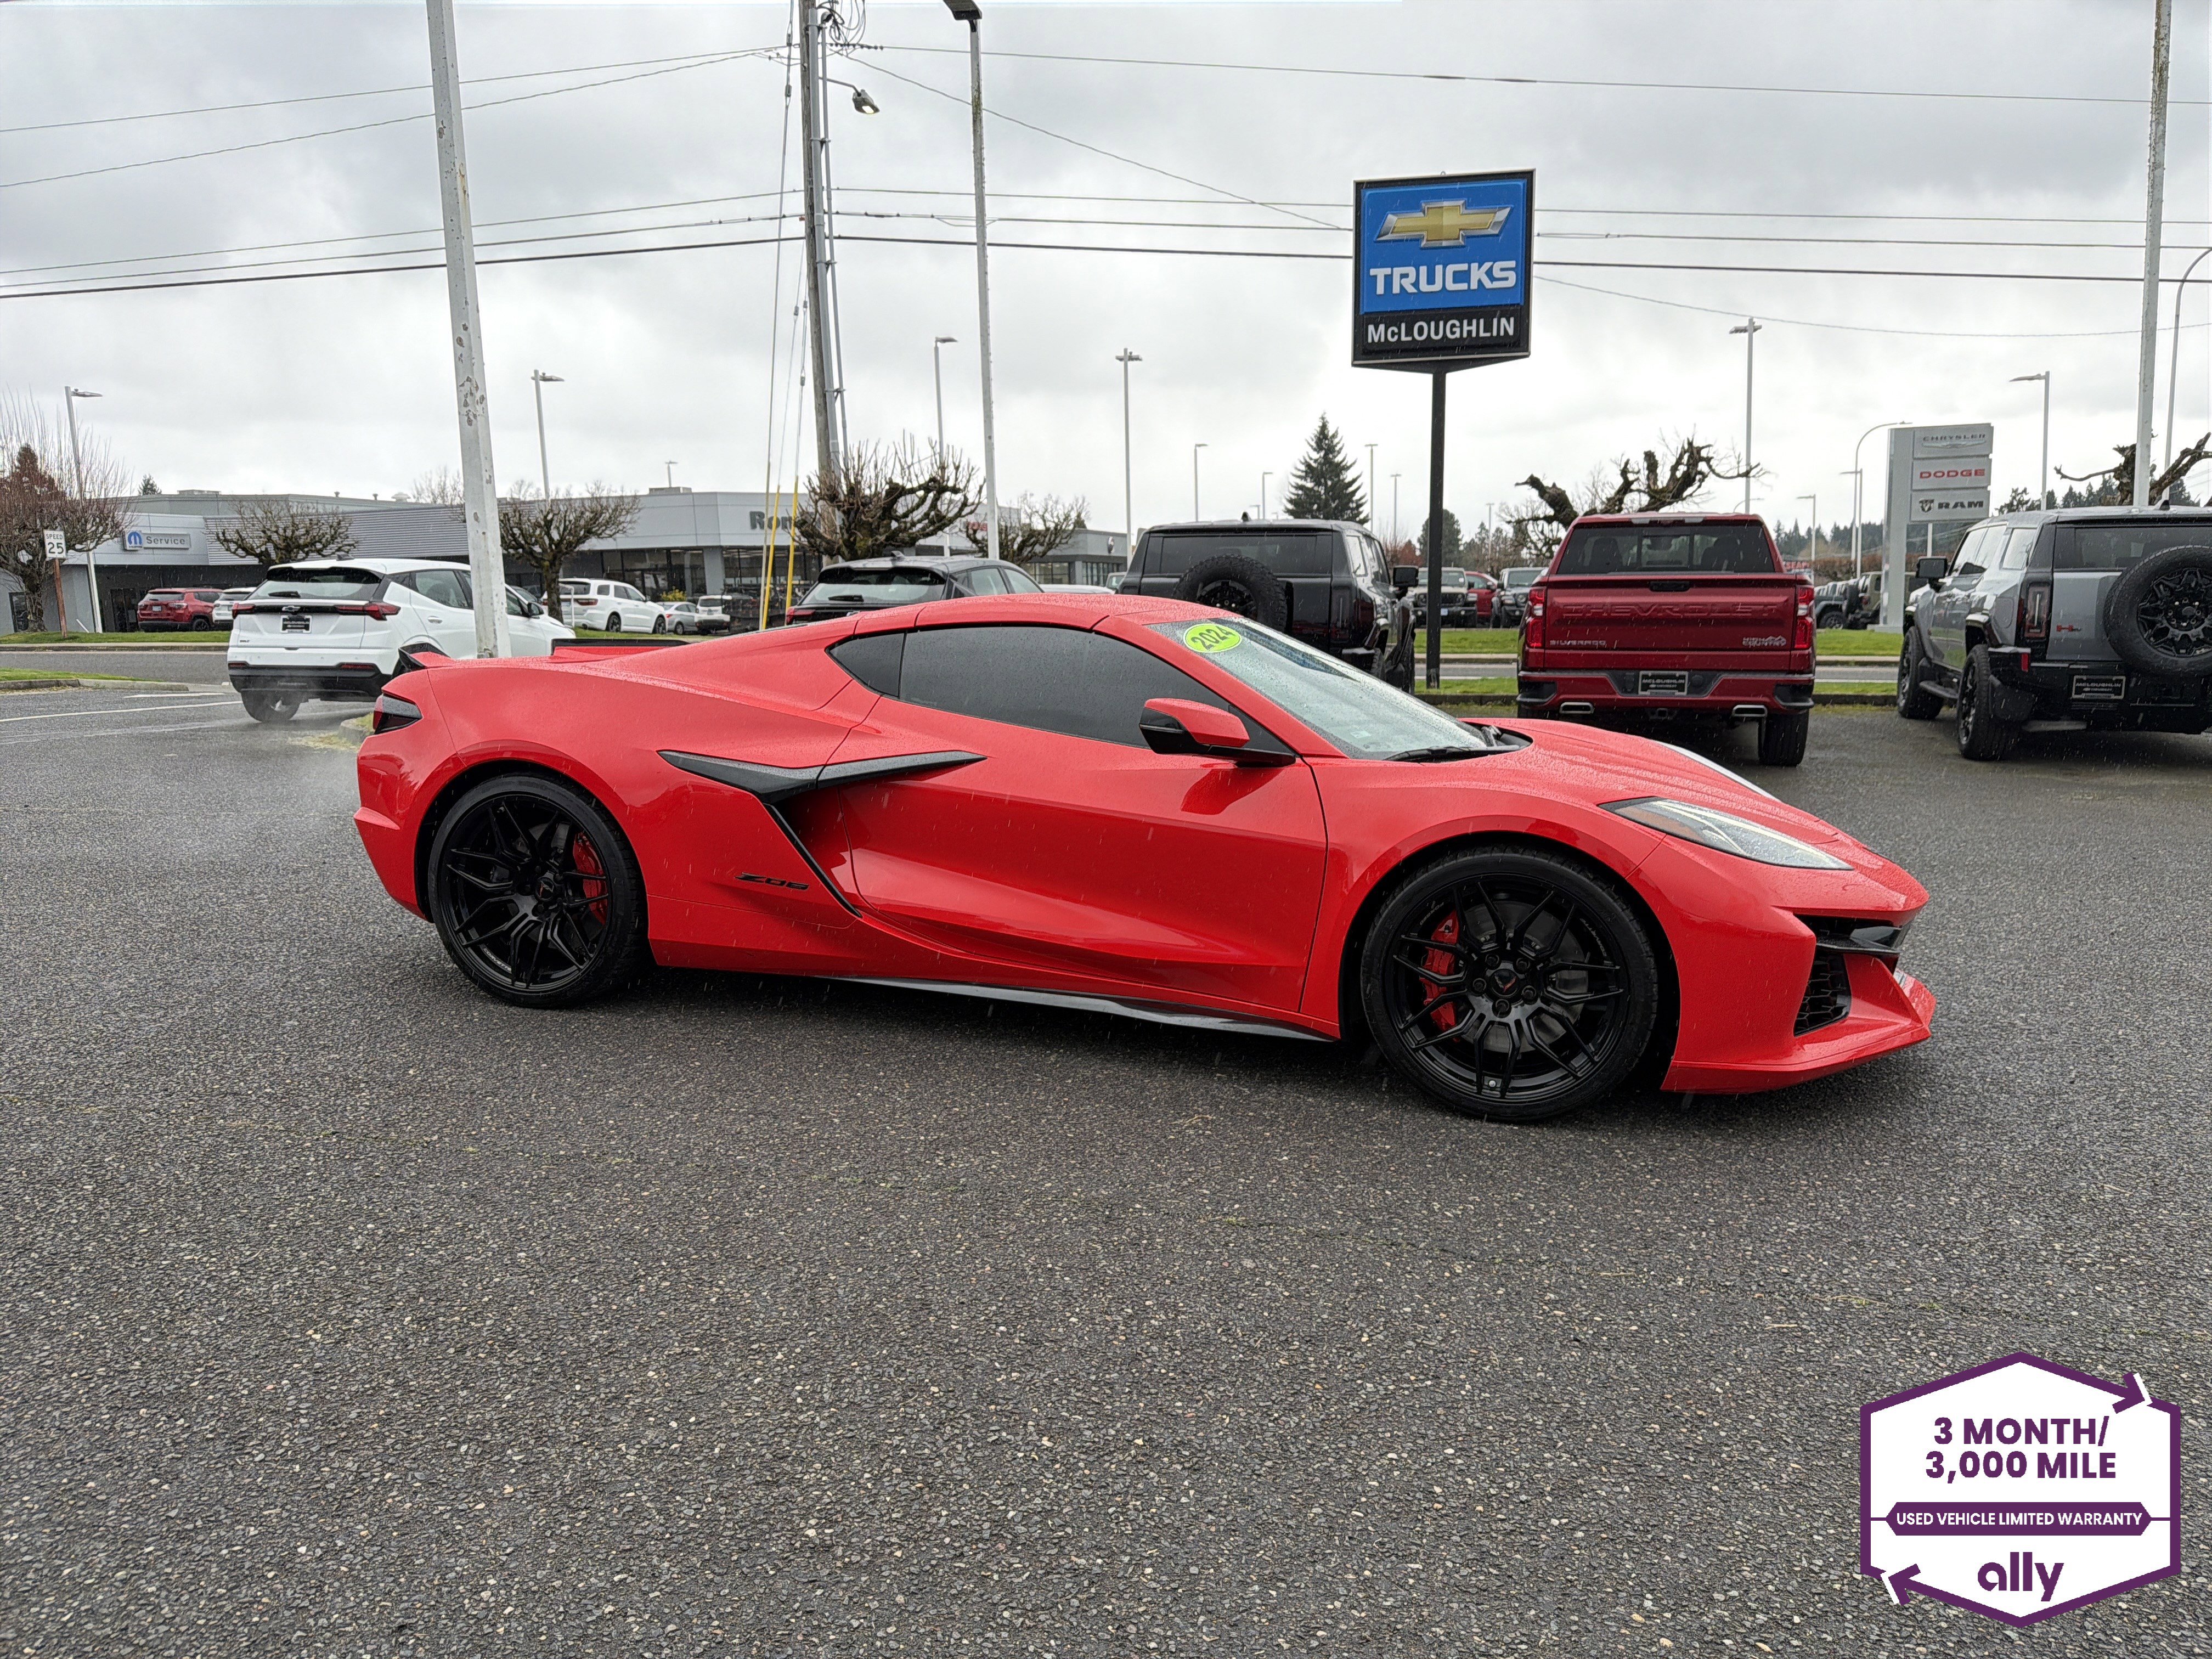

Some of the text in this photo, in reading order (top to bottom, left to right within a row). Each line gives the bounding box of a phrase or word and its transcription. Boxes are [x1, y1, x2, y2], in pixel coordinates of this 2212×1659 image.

[1369, 260, 1516, 295] TRUCKS
[1368, 317, 1515, 343] McLOUGHLIN
[1923, 433, 1985, 442] CHRYSLER
[1920, 469, 1985, 479] DODGE
[1938, 500, 1984, 510] RAM
[145, 535, 185, 545] Service
[47, 541, 64, 554] 25
[1562, 603, 1778, 617] CHEVROLET
[1190, 625, 1236, 650] 2024
